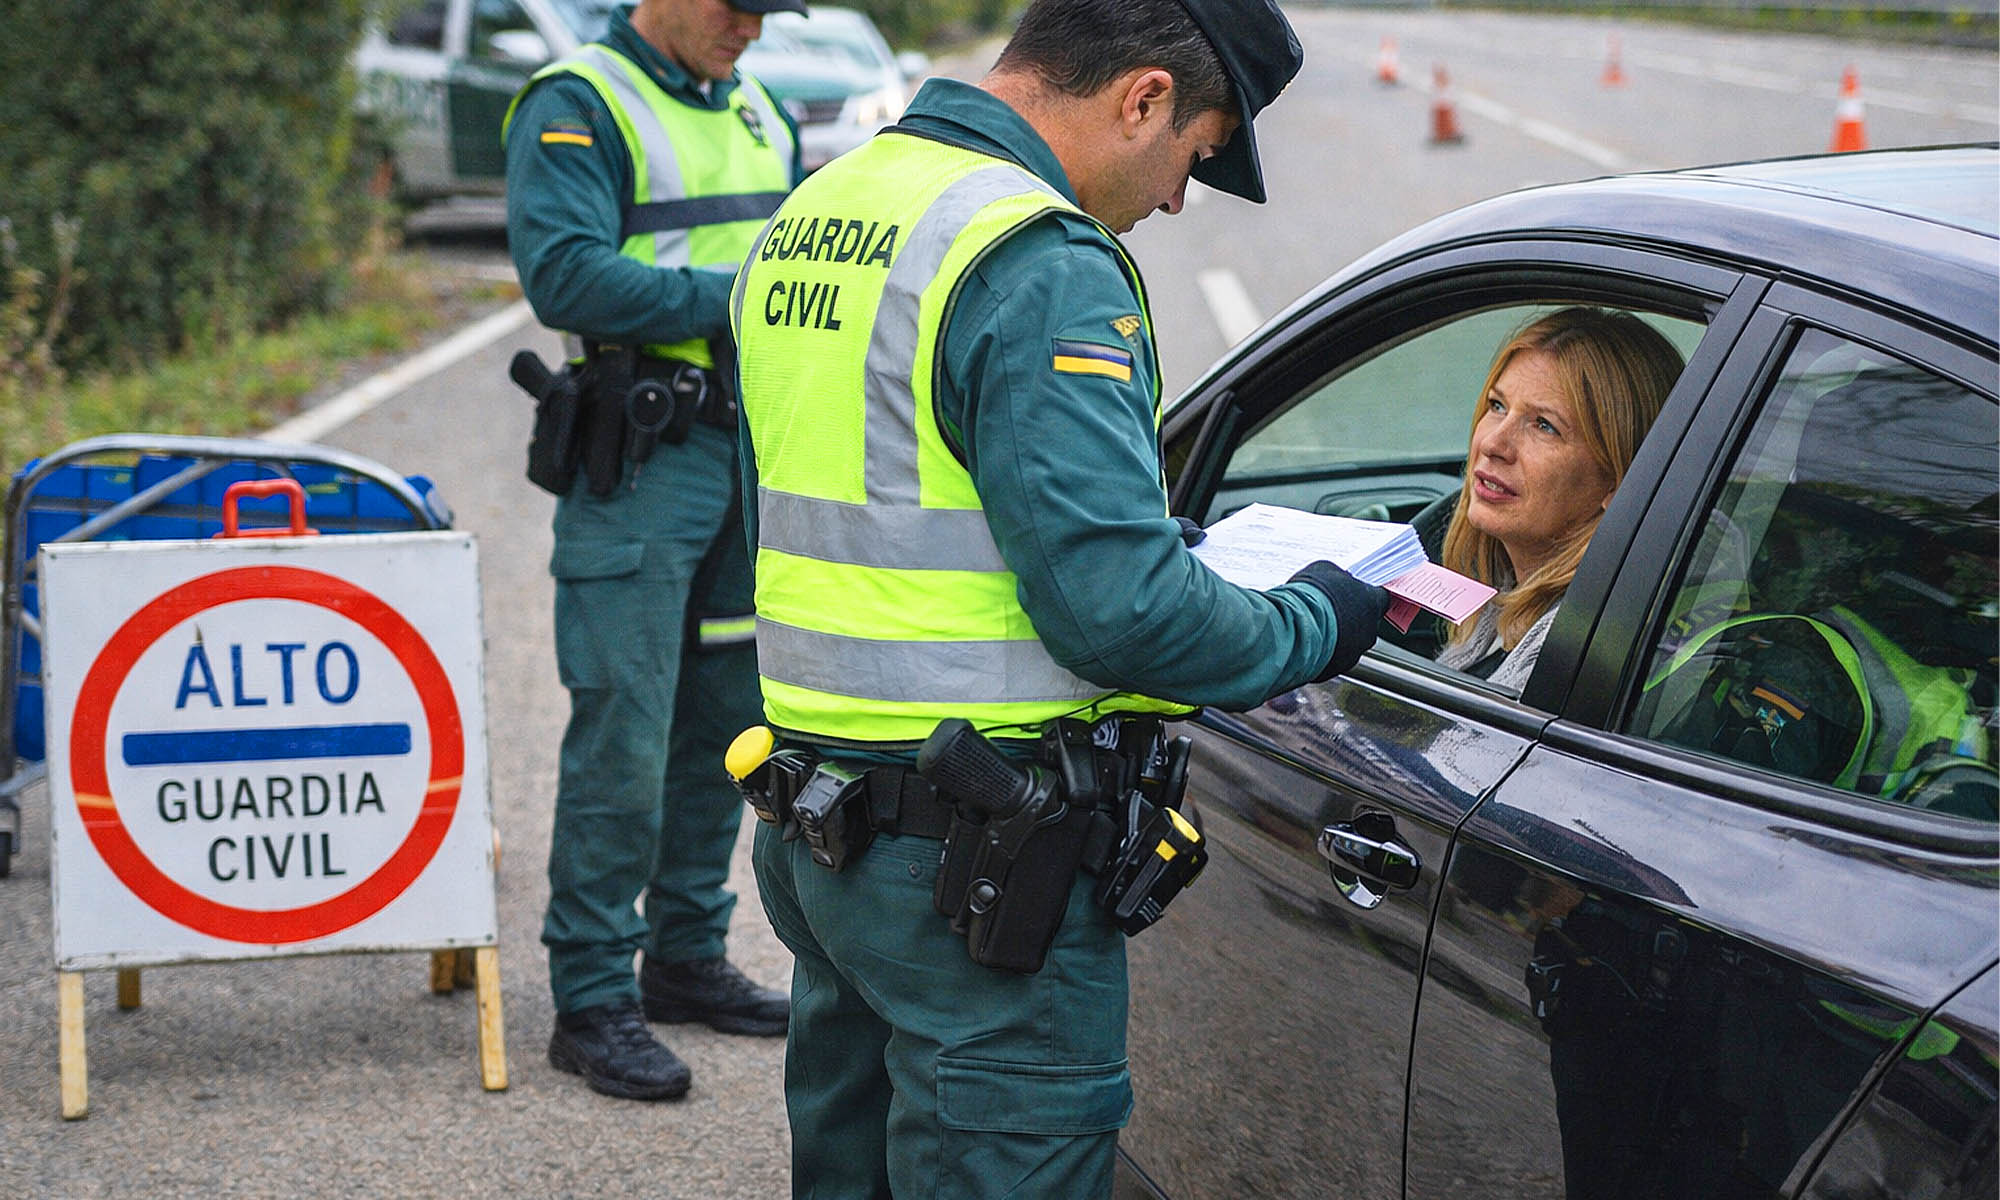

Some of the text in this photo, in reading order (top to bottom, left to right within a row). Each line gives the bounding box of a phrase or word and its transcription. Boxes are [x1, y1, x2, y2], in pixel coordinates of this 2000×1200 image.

[762, 217, 899, 268] GUARDIA
[765, 281, 841, 331] CIVIL
[175, 641, 360, 709] ALTO
[157, 771, 385, 823] GUARDIA
[208, 833, 346, 882] CIVIL
